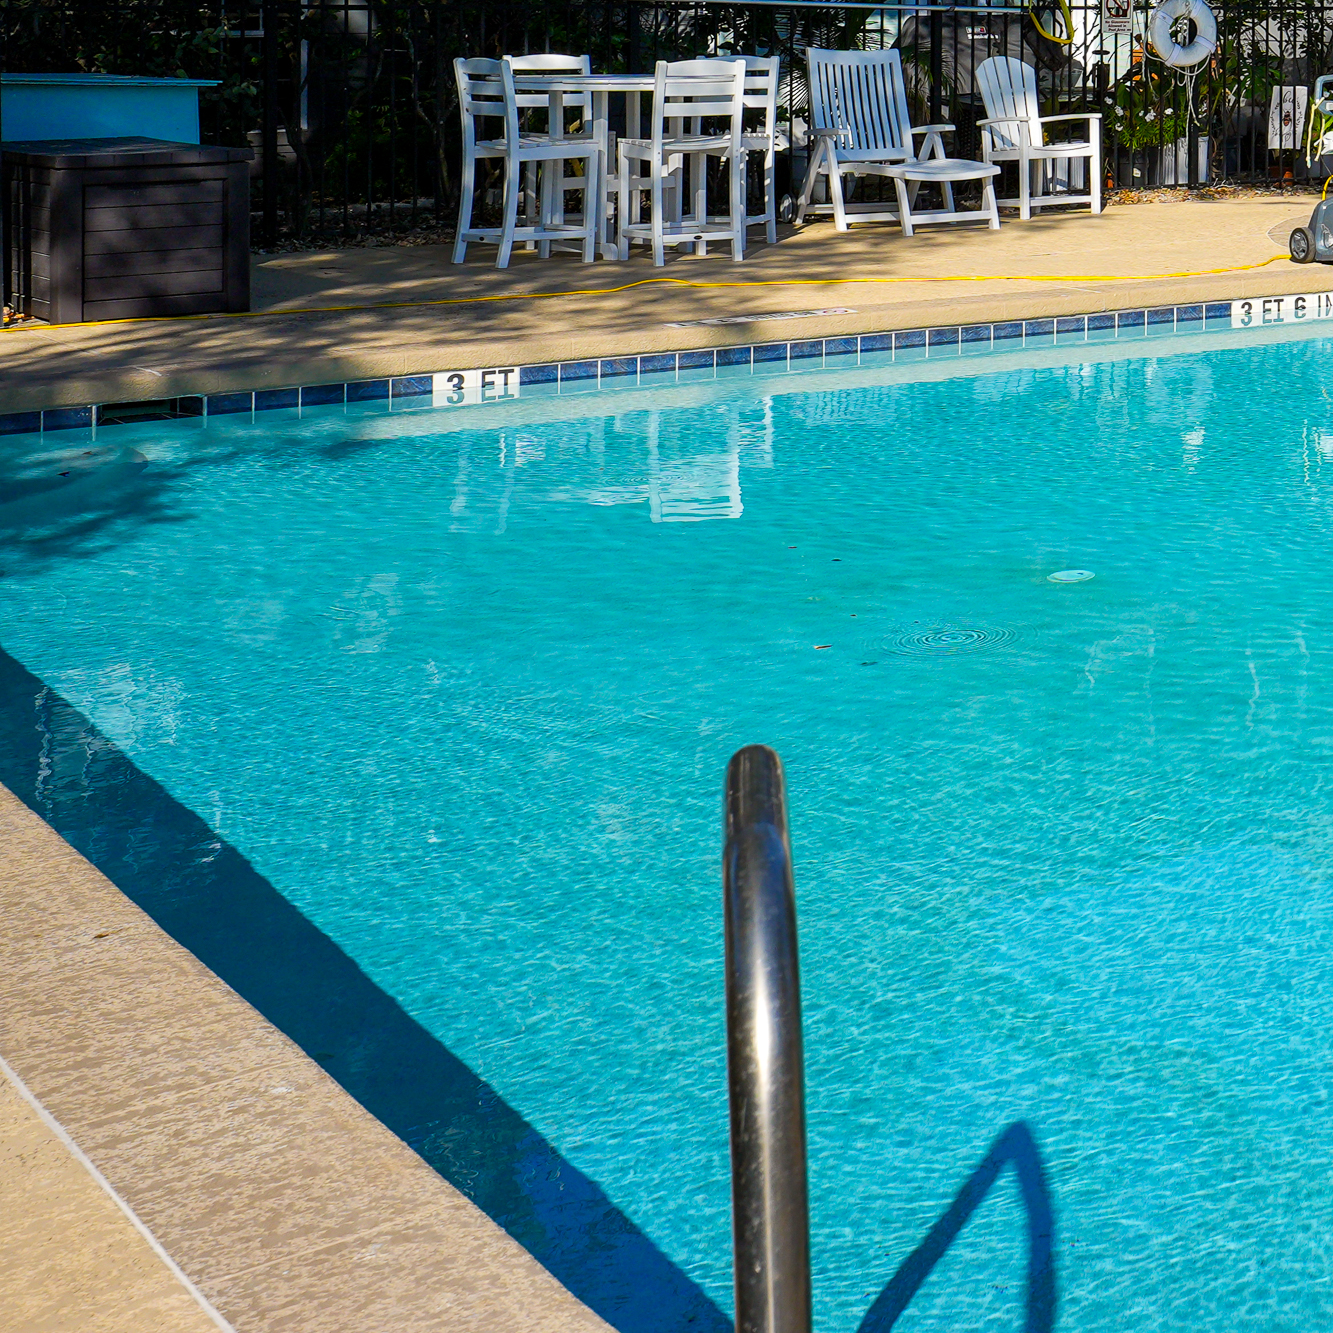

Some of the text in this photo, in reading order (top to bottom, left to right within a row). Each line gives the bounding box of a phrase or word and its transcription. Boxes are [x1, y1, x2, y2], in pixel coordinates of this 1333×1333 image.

[1240, 302, 1253, 316] 3
[446, 368, 515, 392] 3 FT
